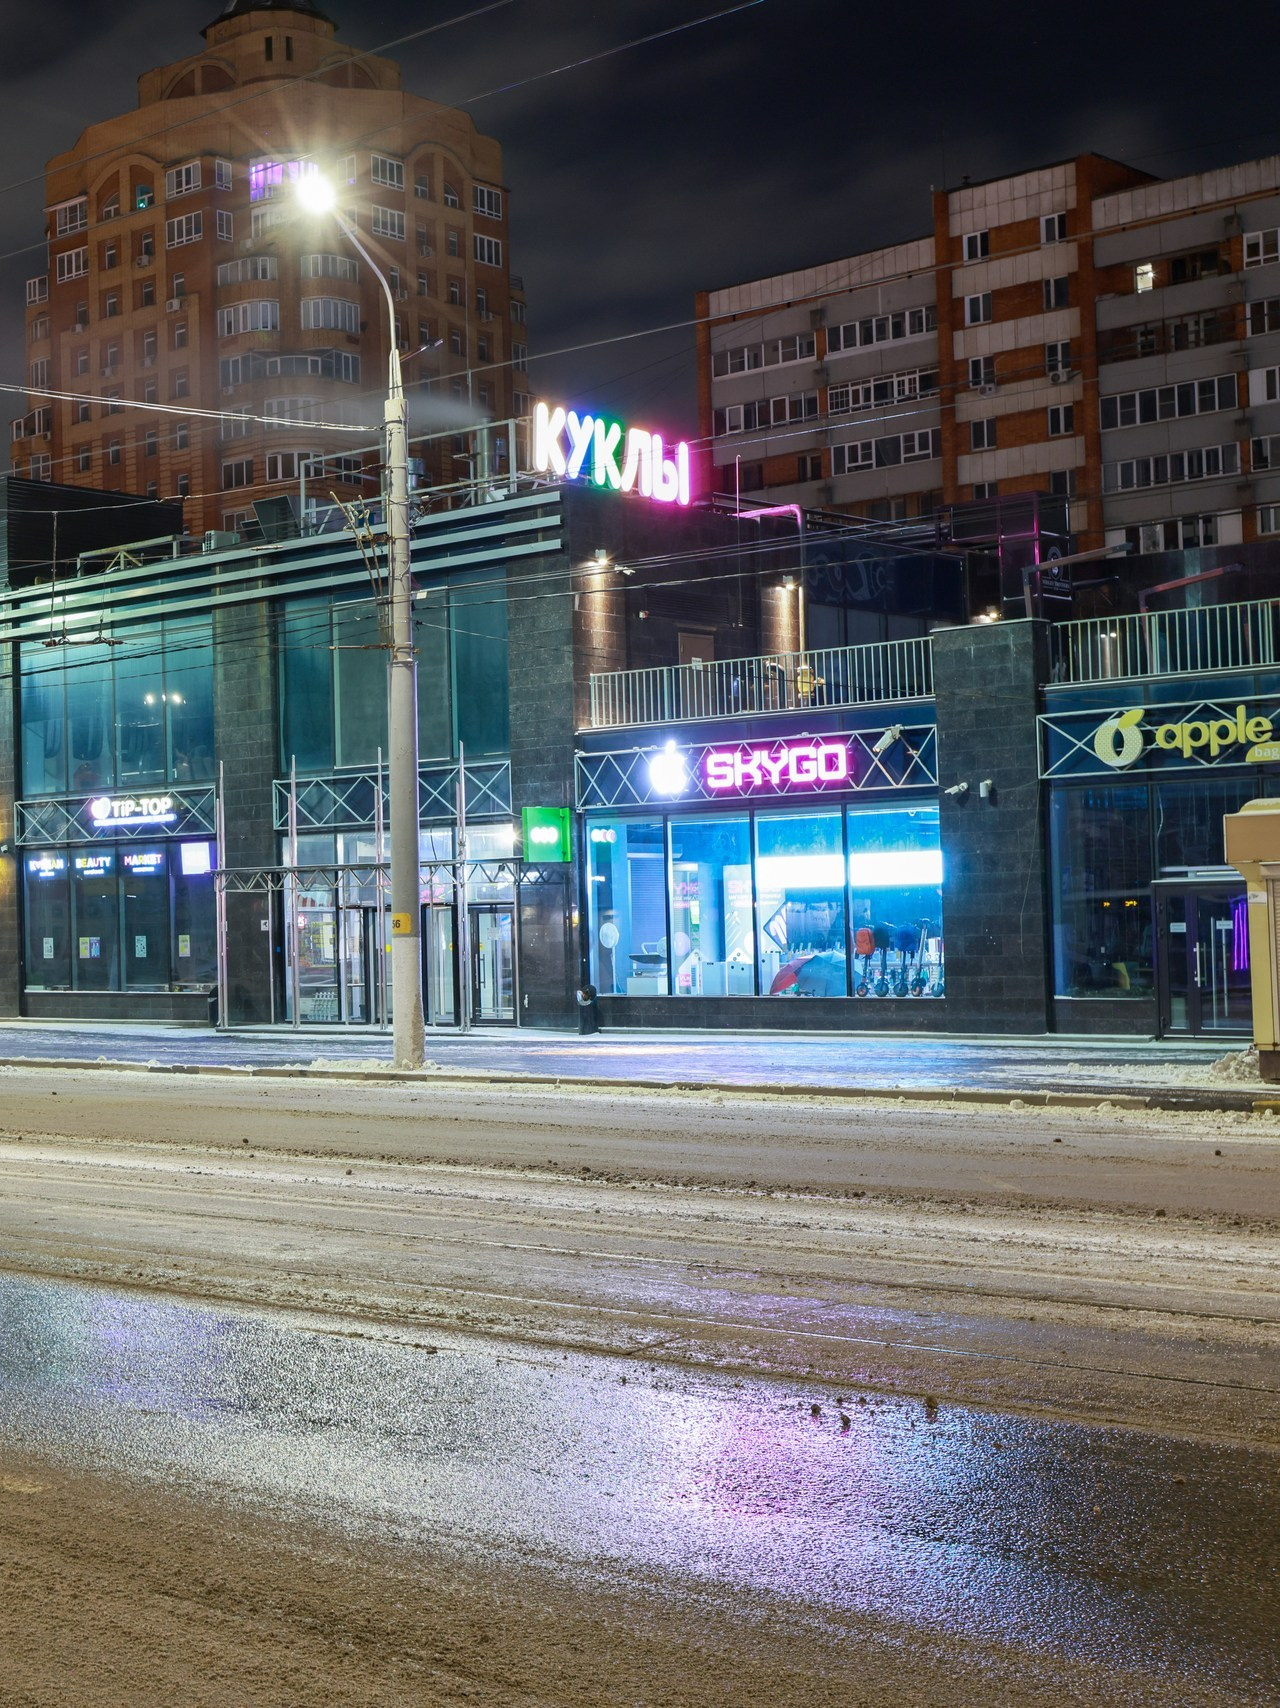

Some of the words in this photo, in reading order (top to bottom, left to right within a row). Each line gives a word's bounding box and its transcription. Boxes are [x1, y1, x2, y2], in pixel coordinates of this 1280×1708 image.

[533, 402, 689, 506] КУКЛЫ
[1155, 704, 1273, 758] apple
[707, 744, 847, 788] SKYGO
[76, 856, 111, 869] BEAUTY
[124, 853, 162, 866] MARKET
